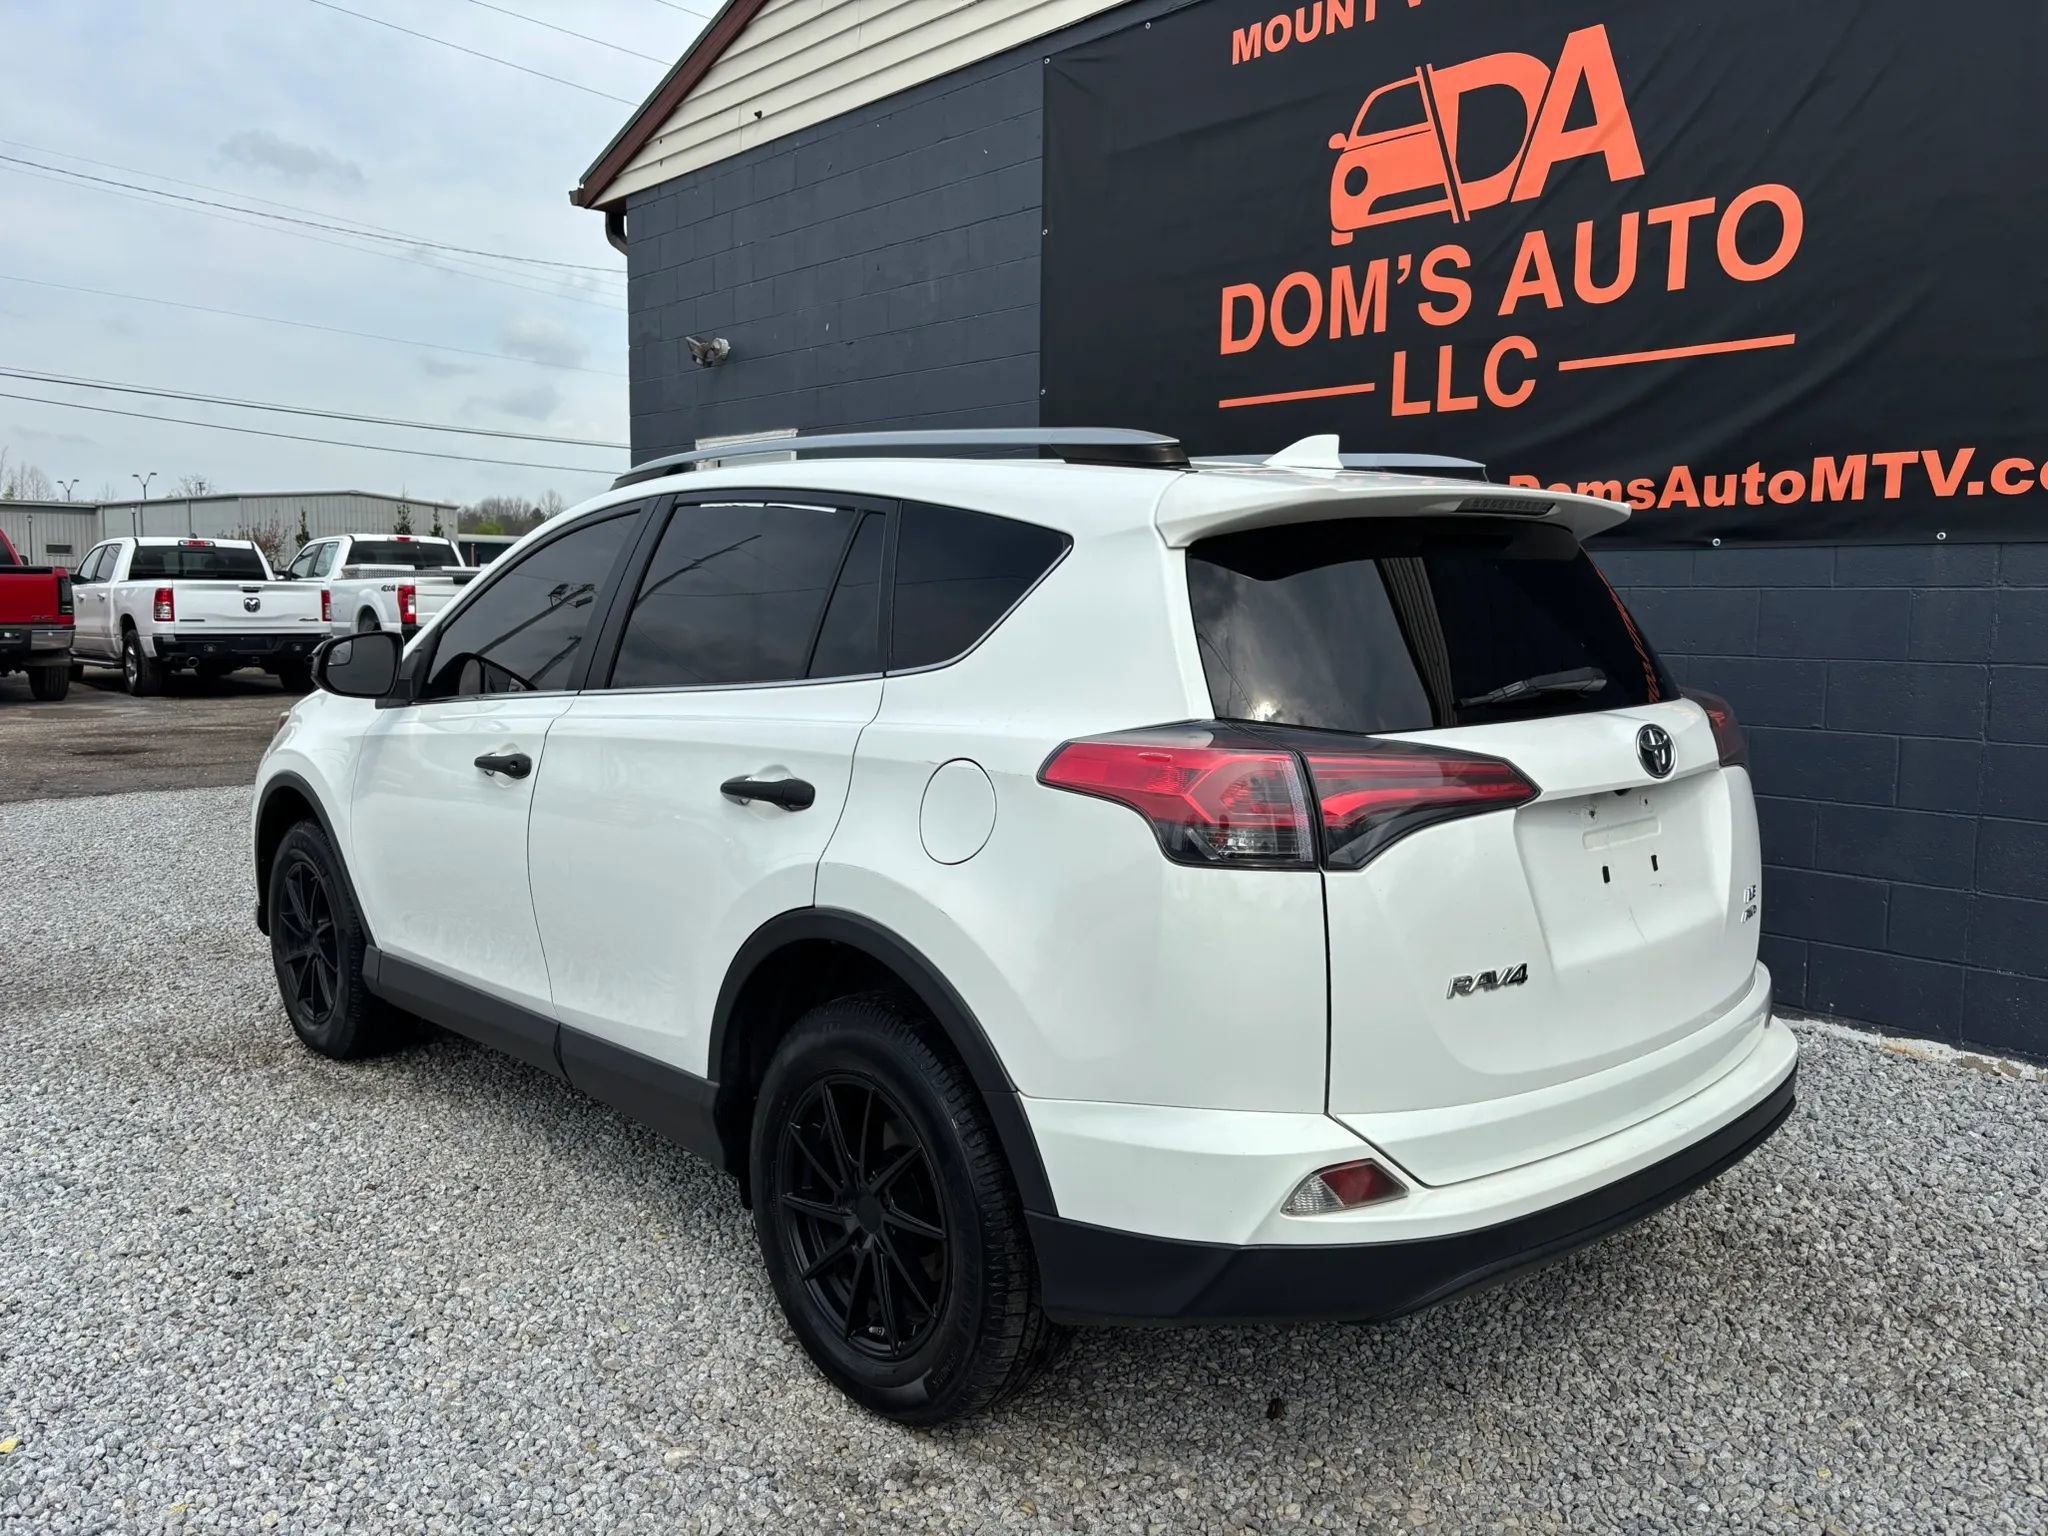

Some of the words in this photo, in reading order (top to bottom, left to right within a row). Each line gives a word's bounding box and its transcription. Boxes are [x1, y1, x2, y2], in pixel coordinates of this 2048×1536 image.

[1220, 245, 1472, 355] DOM'S
[1498, 184, 1804, 316] AUTO
[1391, 336, 1538, 417] LLC
[1509, 447, 2048, 510] msAutoMTV.c
[1446, 962, 1529, 1000] RAV4
